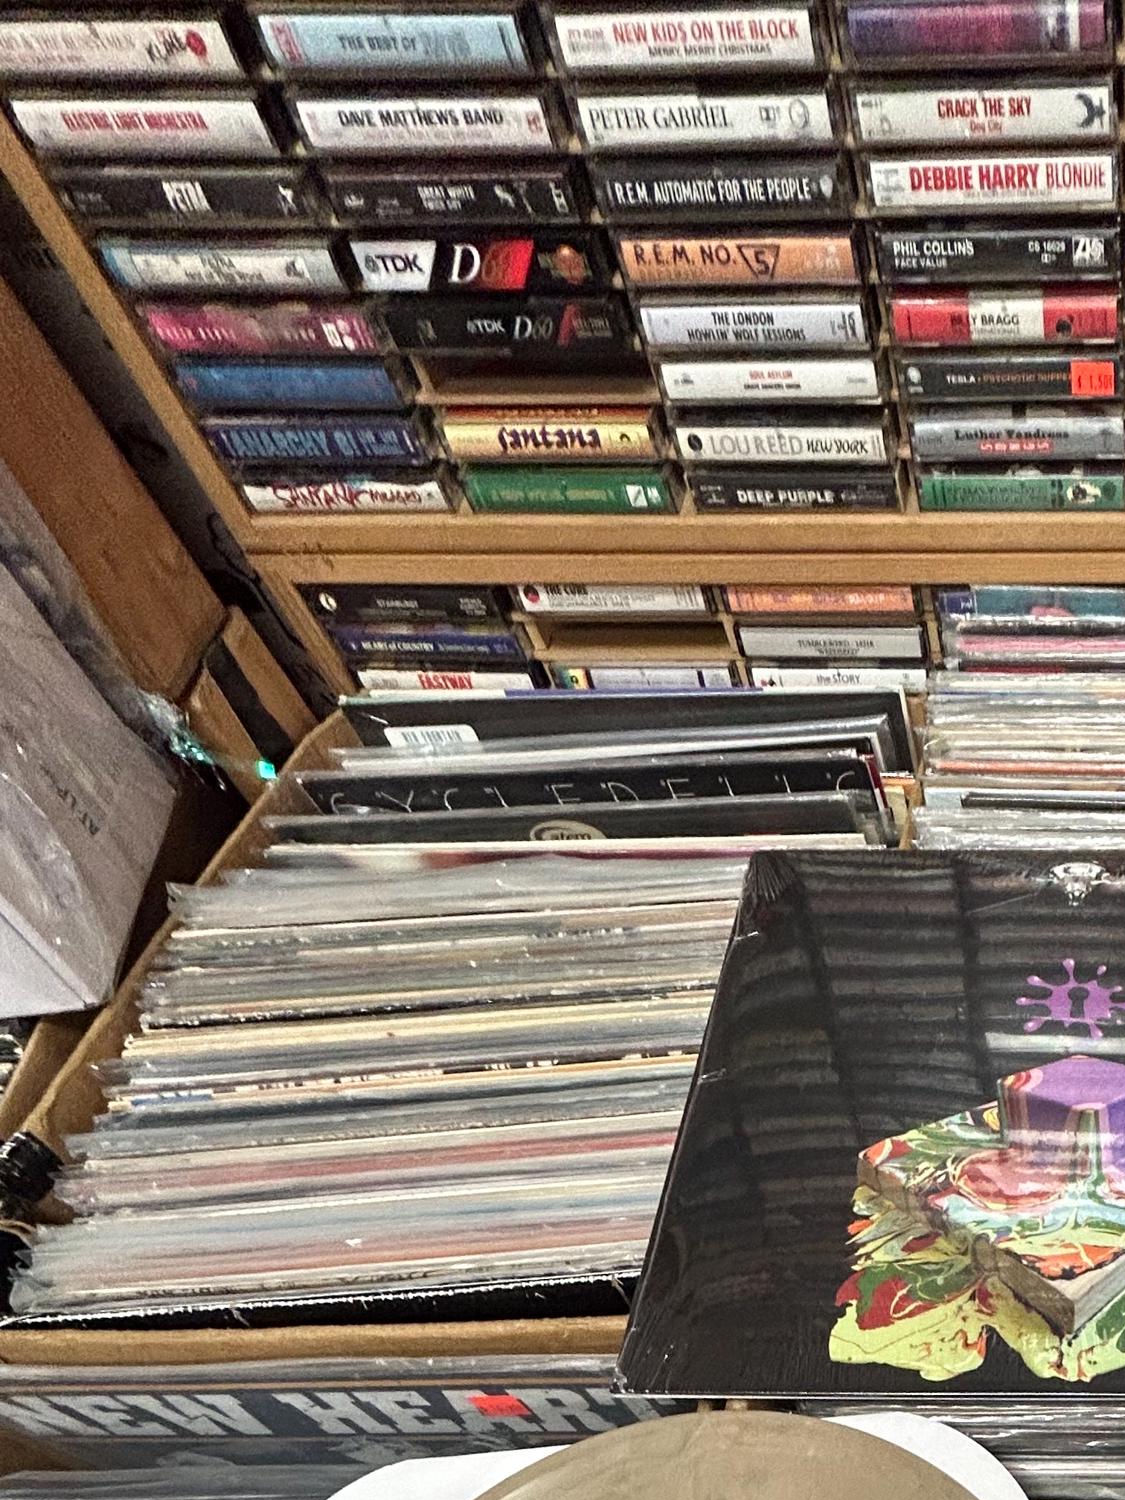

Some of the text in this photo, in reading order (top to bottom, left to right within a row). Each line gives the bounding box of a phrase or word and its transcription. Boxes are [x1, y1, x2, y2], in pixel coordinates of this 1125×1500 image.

[612, 22, 648, 43] NEW
[651, 21, 687, 42] KIDS
[691, 20, 713, 41] ON
[717, 20, 744, 40] THE
[749, 19, 799, 40] BLOCK
[937, 96, 1032, 119] CRACK THE SKY
[338, 108, 505, 127] DAVE MATTHEWS BAND
[589, 105, 731, 131] PETER GABRIEL
[908, 166, 974, 192] DEBBIE
[978, 164, 1040, 190] HARRY
[1045, 162, 1106, 188] BLONDIE
[652, 177, 812, 204] AUTOMATIC FOR THE PEOPLE
[893, 239, 974, 256] PHIL COLLINS
[376, 254, 424, 274] TDK
[753, 250, 771, 276] 5
[895, 257, 947, 269] FACE VALUE
[711, 311, 775, 326] THE LONDON
[981, 314, 1020, 326] BRAGG
[687, 328, 806, 342] HOWLIN' WOLF SESSIONS
[946, 374, 977, 384] TESLA
[954, 428, 1070, 441] Luther Vandross
[709, 434, 750, 455] LOU
[754, 434, 803, 456] REED
[736, 489, 834, 504] DEEP PURPLE
[417, 673, 473, 689] FASTWAY
[832, 673, 860, 684] STORY
[0, 1392, 273, 1438] NEW
